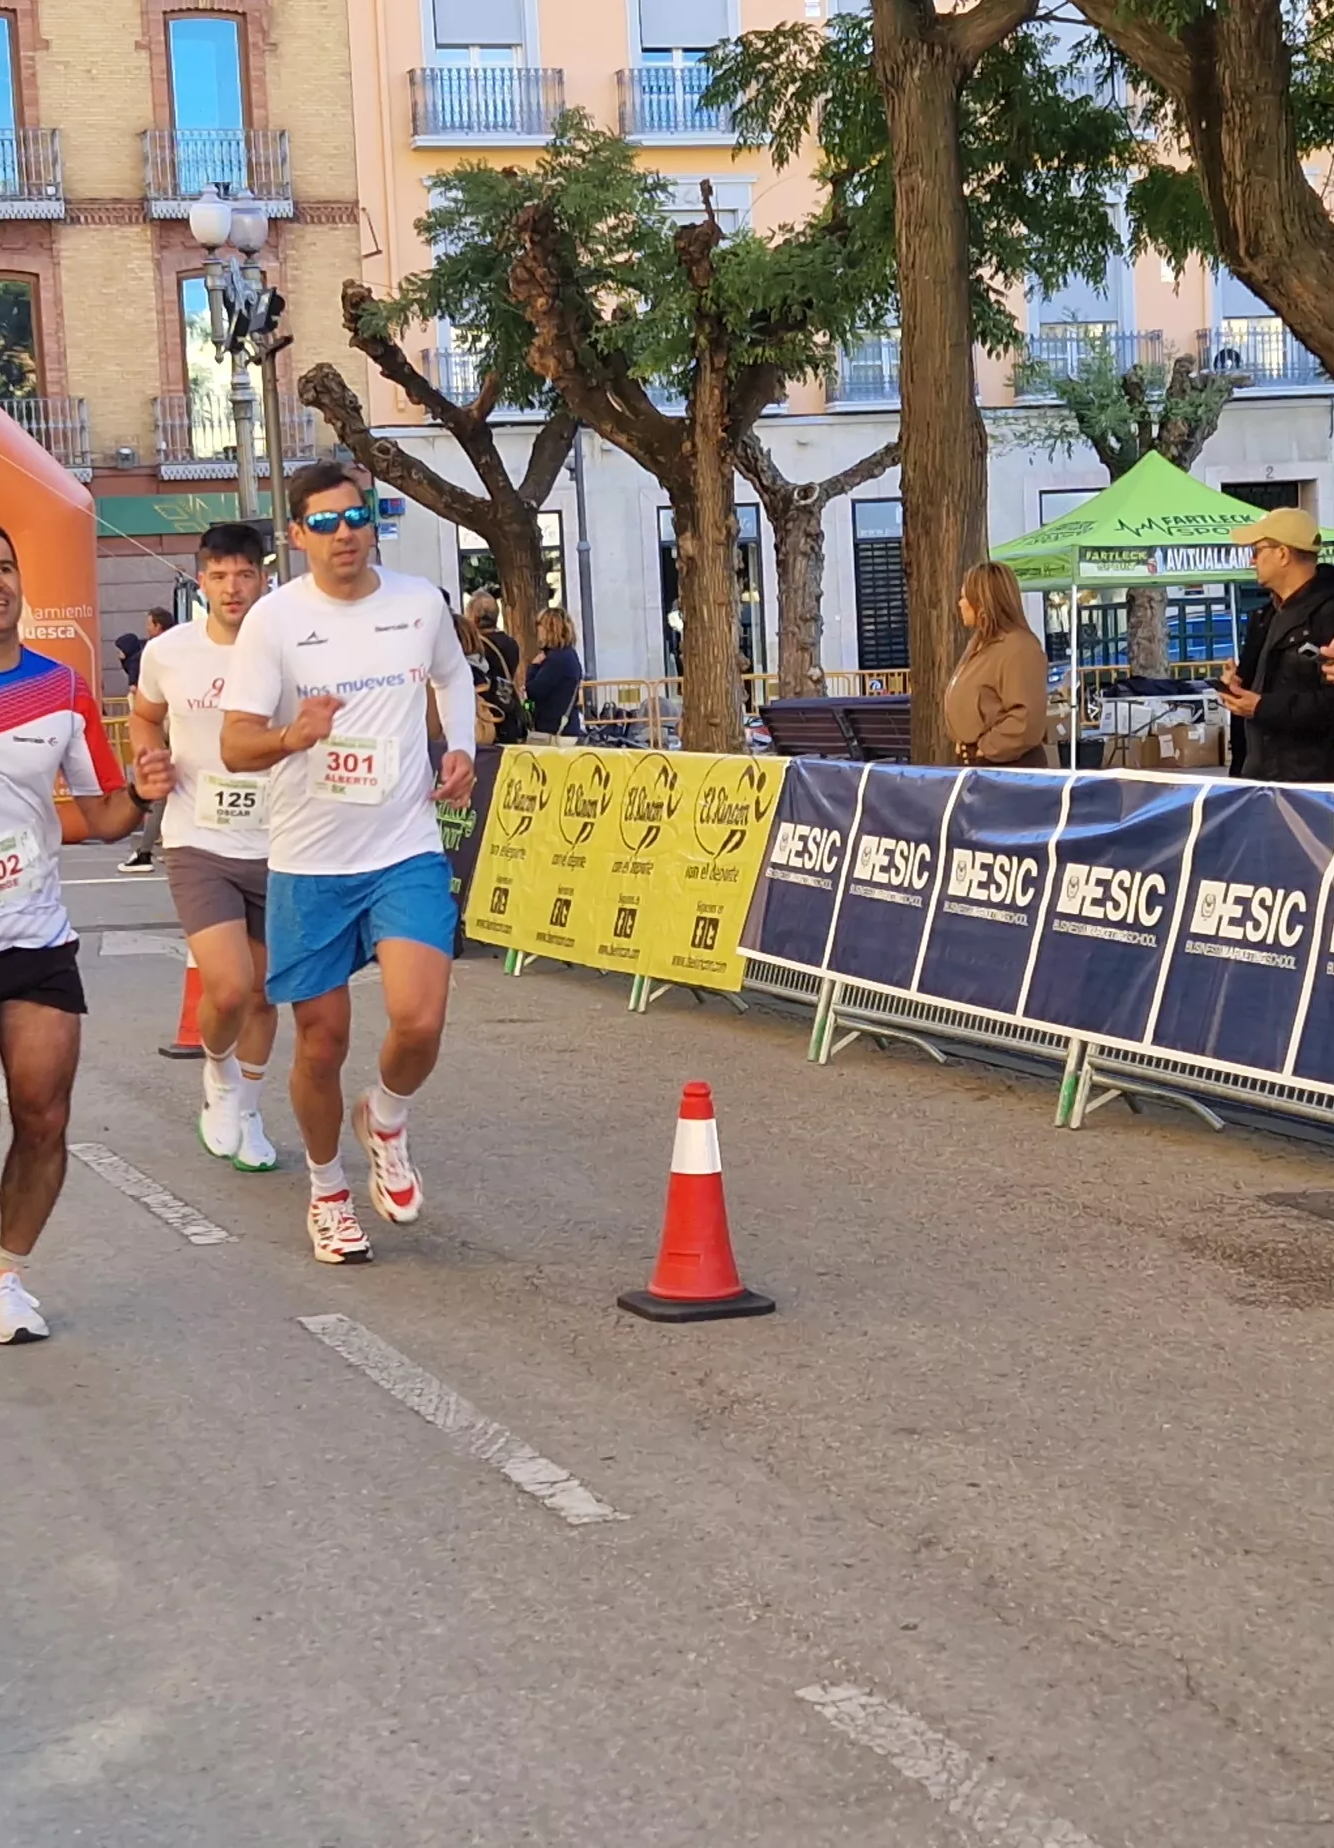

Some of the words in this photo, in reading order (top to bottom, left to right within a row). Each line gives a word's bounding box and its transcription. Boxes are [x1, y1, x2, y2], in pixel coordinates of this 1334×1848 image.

[1266, 465, 1275, 479] 2
[1161, 514, 1255, 525] FARTLECK
[1177, 527, 1230, 536] SPO
[296, 684, 331, 699] Nos
[336, 673, 406, 694] mueves
[327, 752, 375, 775] 301
[325, 773, 378, 787] ALBERTO
[214, 791, 256, 808] 125
[788, 824, 841, 873] ESIC
[871, 836, 931, 890] ESIC
[969, 851, 1038, 907] ESIC
[1081, 866, 1166, 927] ESIC
[1218, 883, 1307, 947] ESIC
